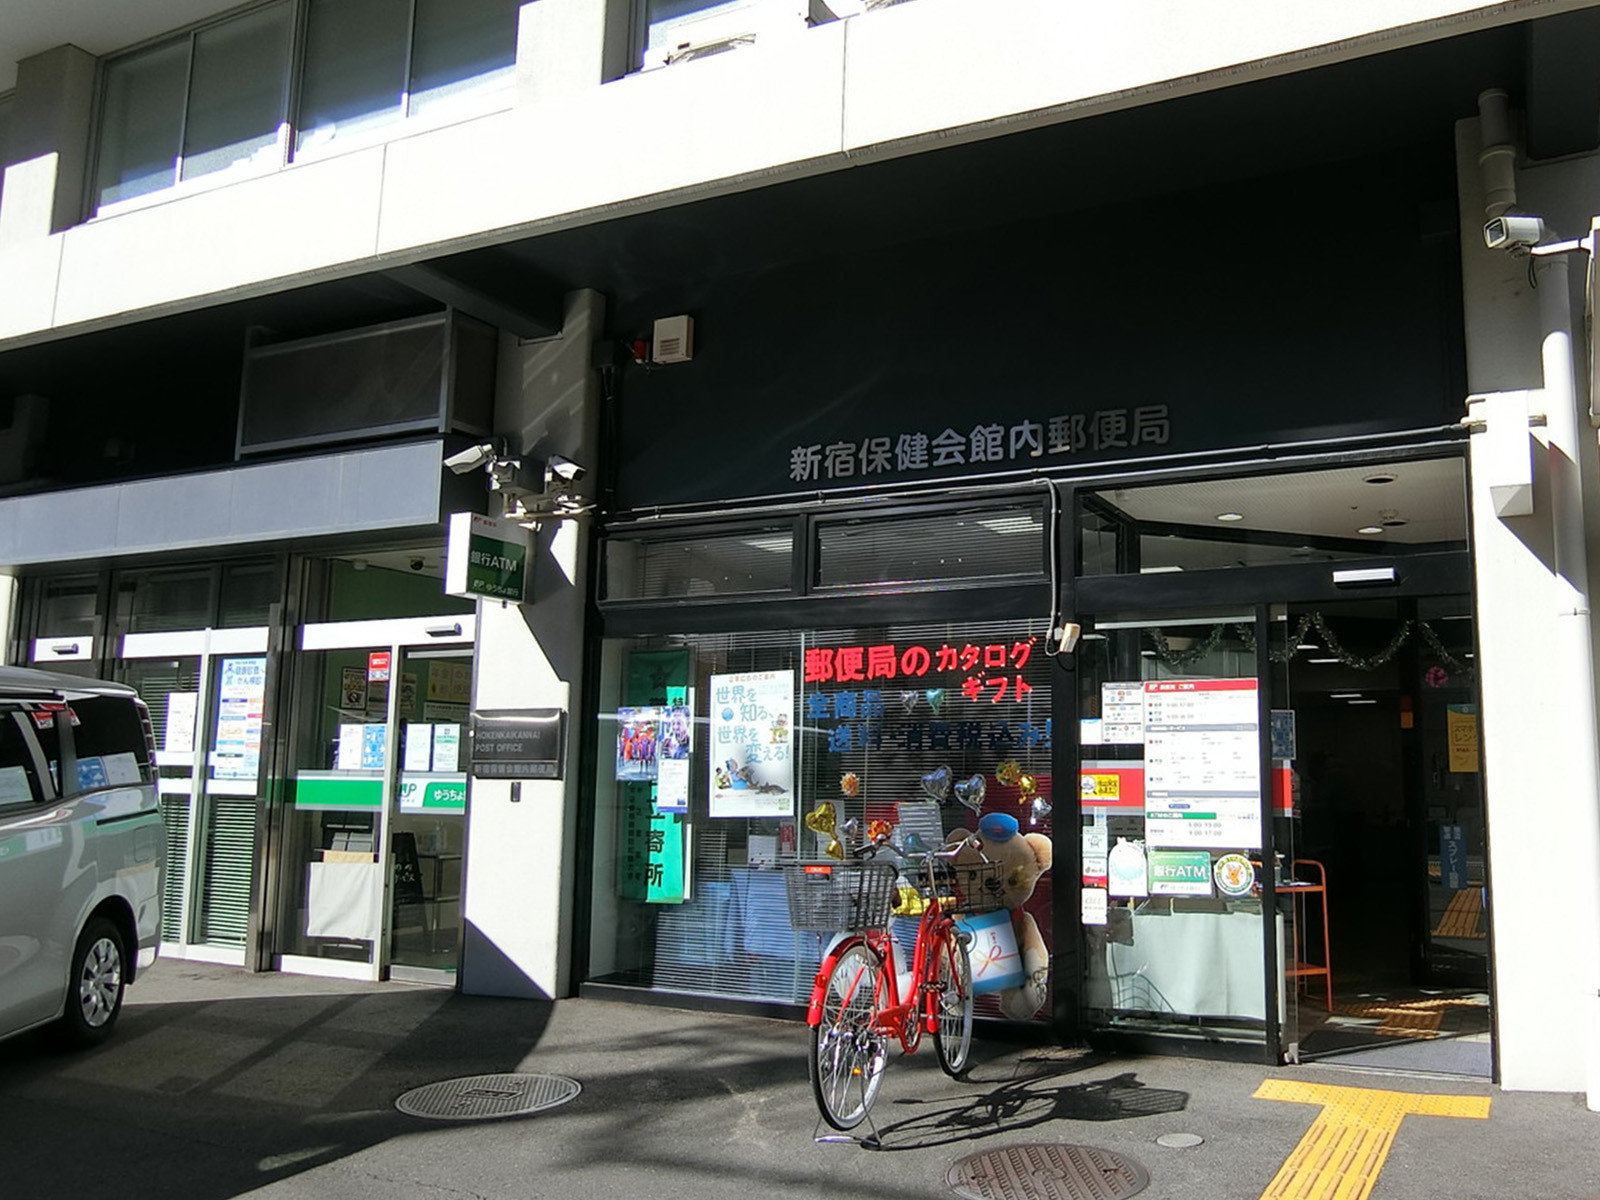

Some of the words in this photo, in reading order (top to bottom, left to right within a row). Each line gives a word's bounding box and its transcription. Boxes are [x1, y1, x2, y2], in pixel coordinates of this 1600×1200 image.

[789, 404, 1170, 482] 新宿保健会館内郵便局
[471, 550, 517, 572] 銀行ATM
[716, 685, 757, 704] 世界を
[961, 671, 1032, 704] ギフト
[806, 690, 885, 719] 全商品
[718, 725, 758, 744] 世界を
[475, 743, 494, 752] POST
[496, 743, 524, 752] OFFICE
[1153, 864, 1207, 878] 銀行ATM
